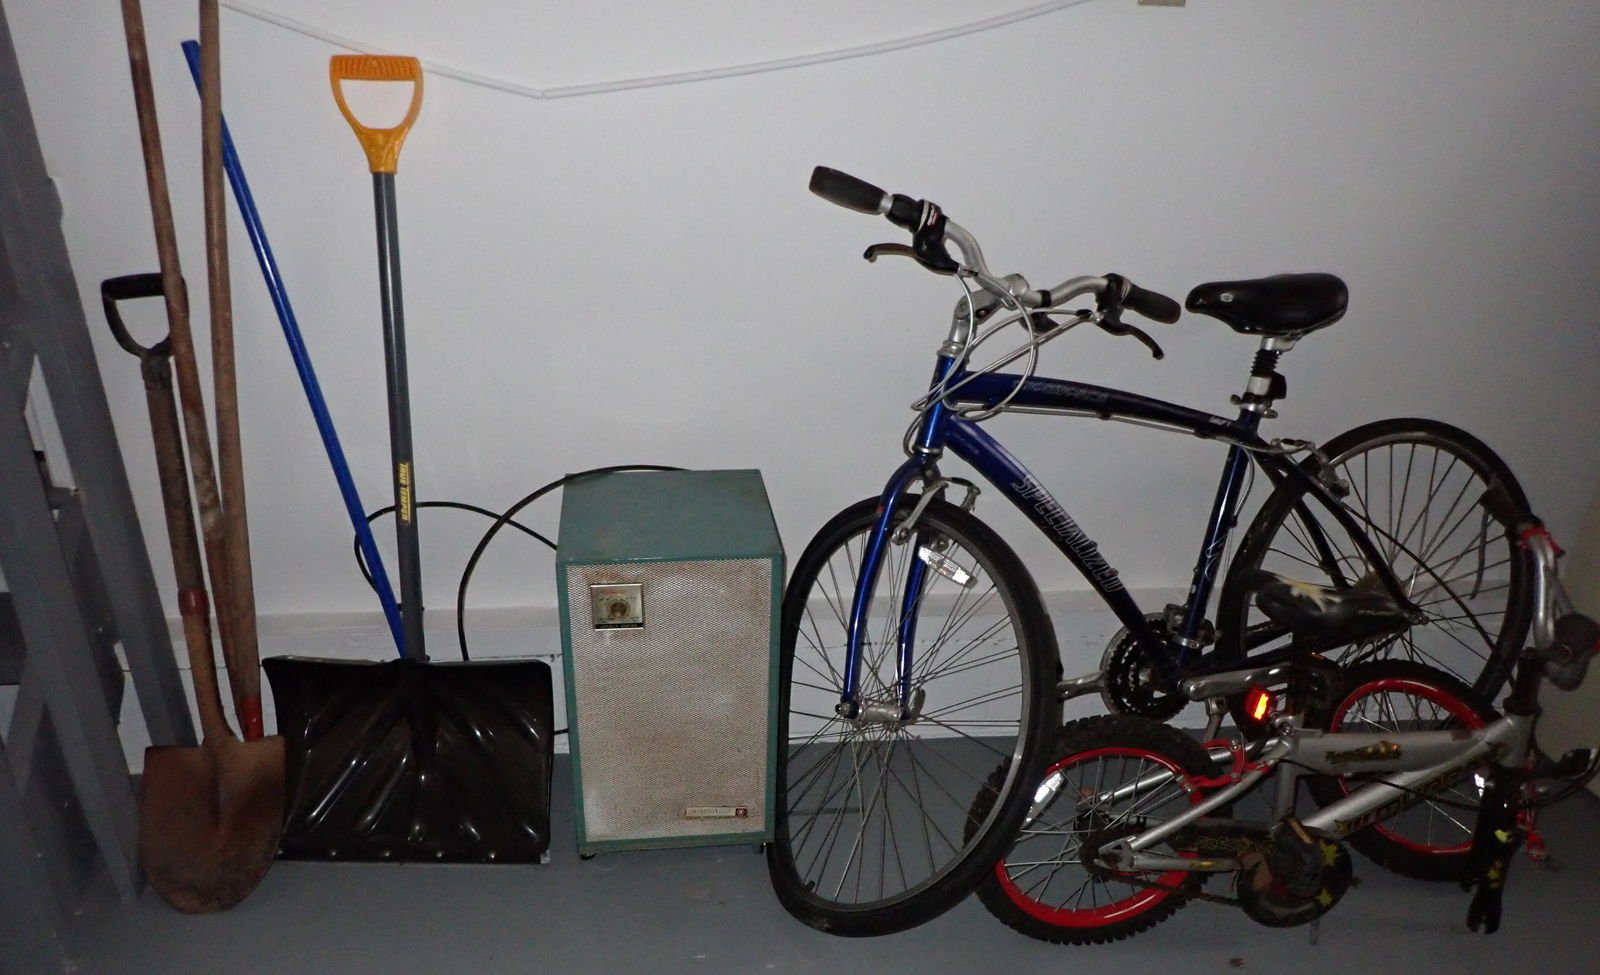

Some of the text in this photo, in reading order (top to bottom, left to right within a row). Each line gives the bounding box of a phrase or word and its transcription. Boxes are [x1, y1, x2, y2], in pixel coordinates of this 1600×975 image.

[399, 463, 410, 522] TRUE TEMPER
[1011, 474, 1123, 593] SPECIALIZED
